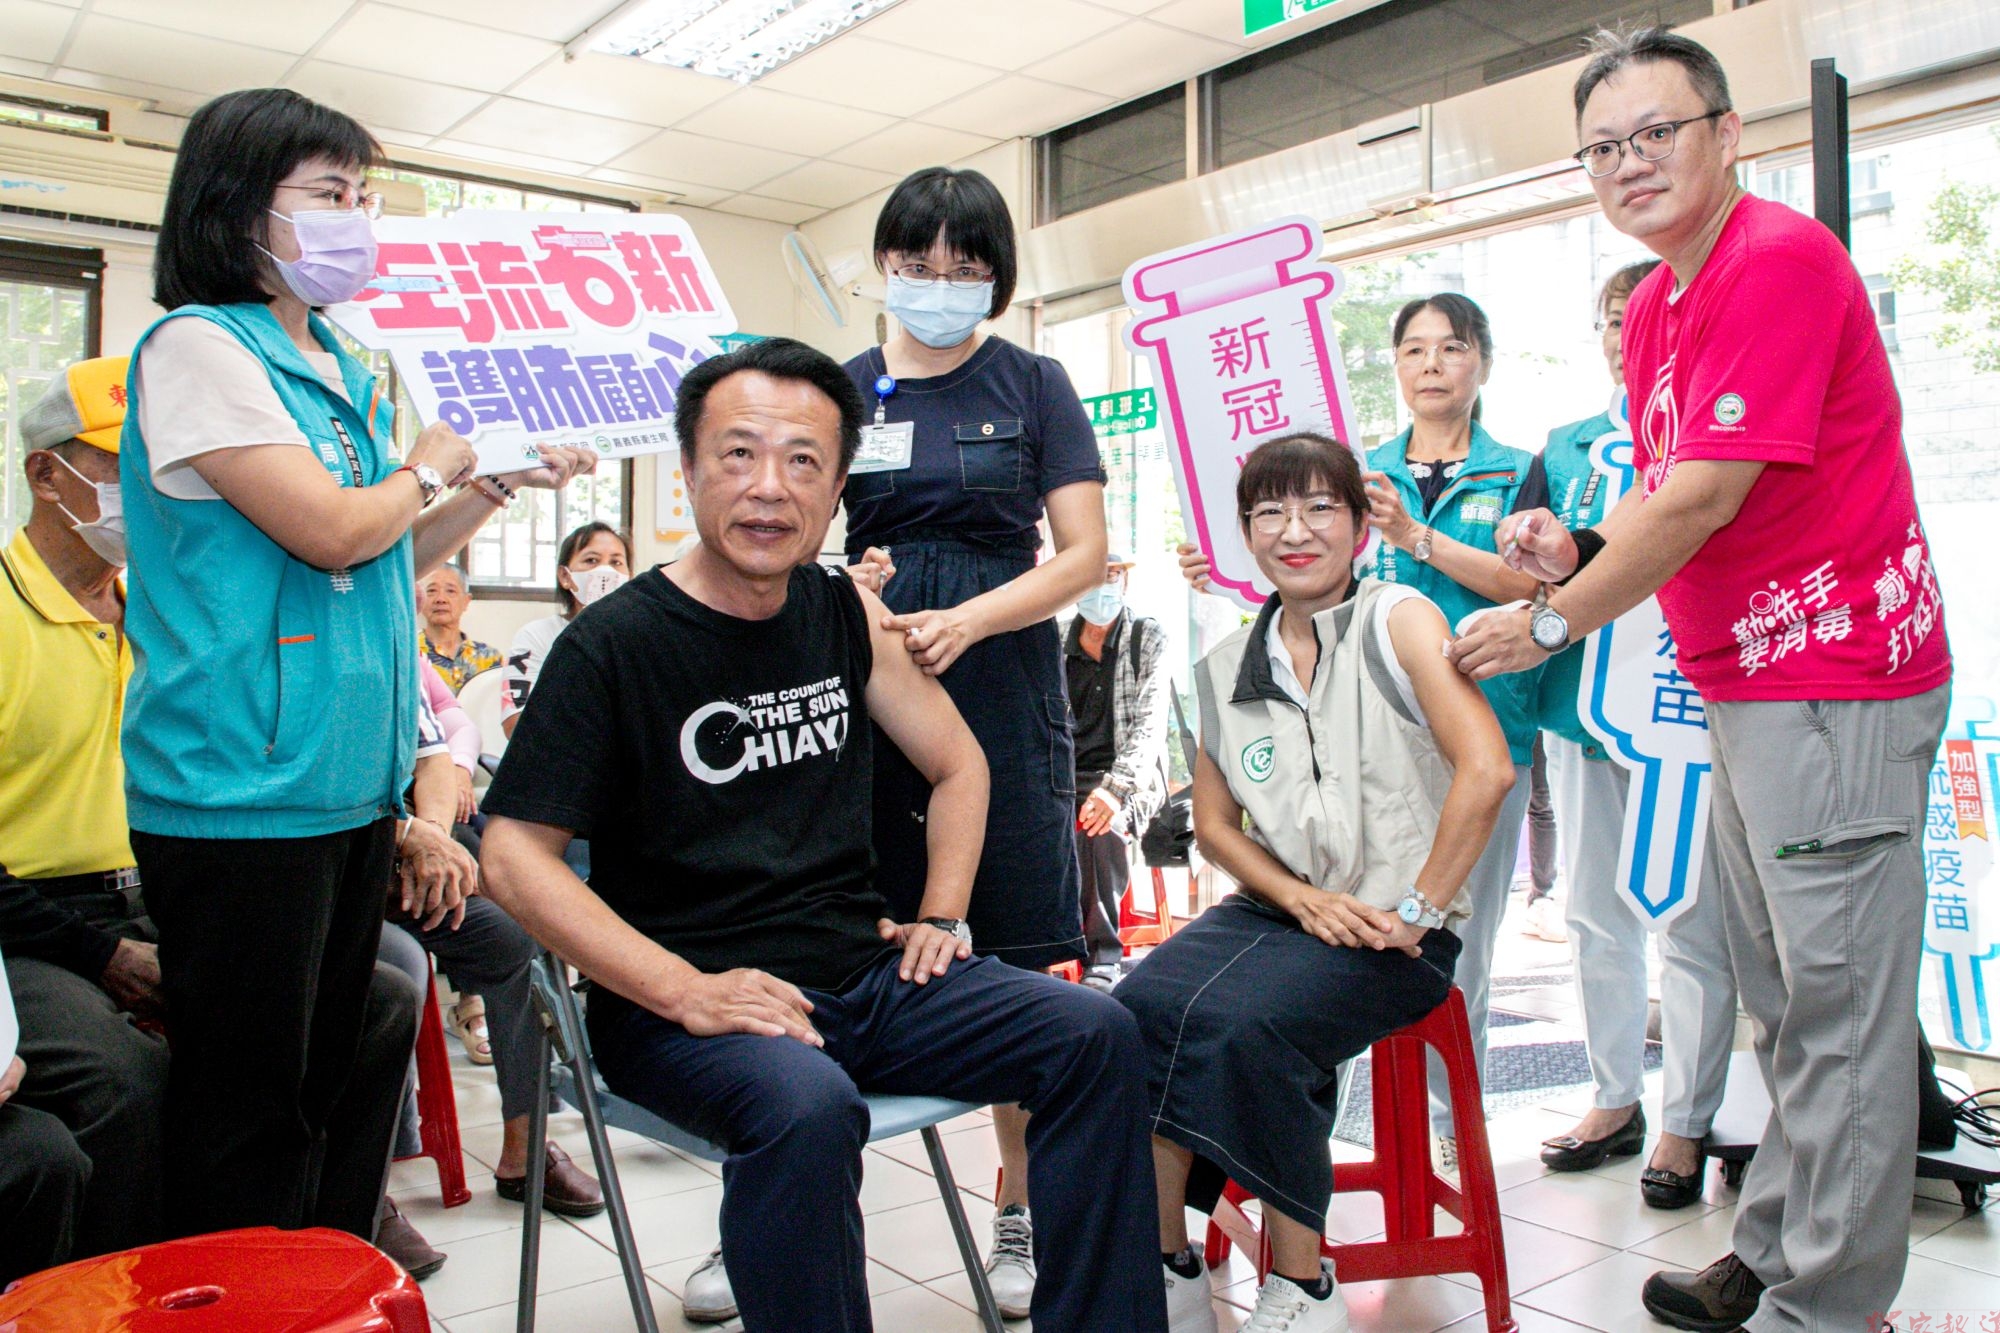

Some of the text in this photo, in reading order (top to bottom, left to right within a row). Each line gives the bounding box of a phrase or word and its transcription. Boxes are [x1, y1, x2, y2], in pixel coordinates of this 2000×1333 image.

[1209, 317, 1290, 469] 新冠
[1738, 603, 1853, 678] 要消毒
[748, 692, 776, 707] THE
[823, 676, 841, 691] OF
[751, 688, 849, 729] THE SUN
[1950, 749, 1983, 822] 加強型
